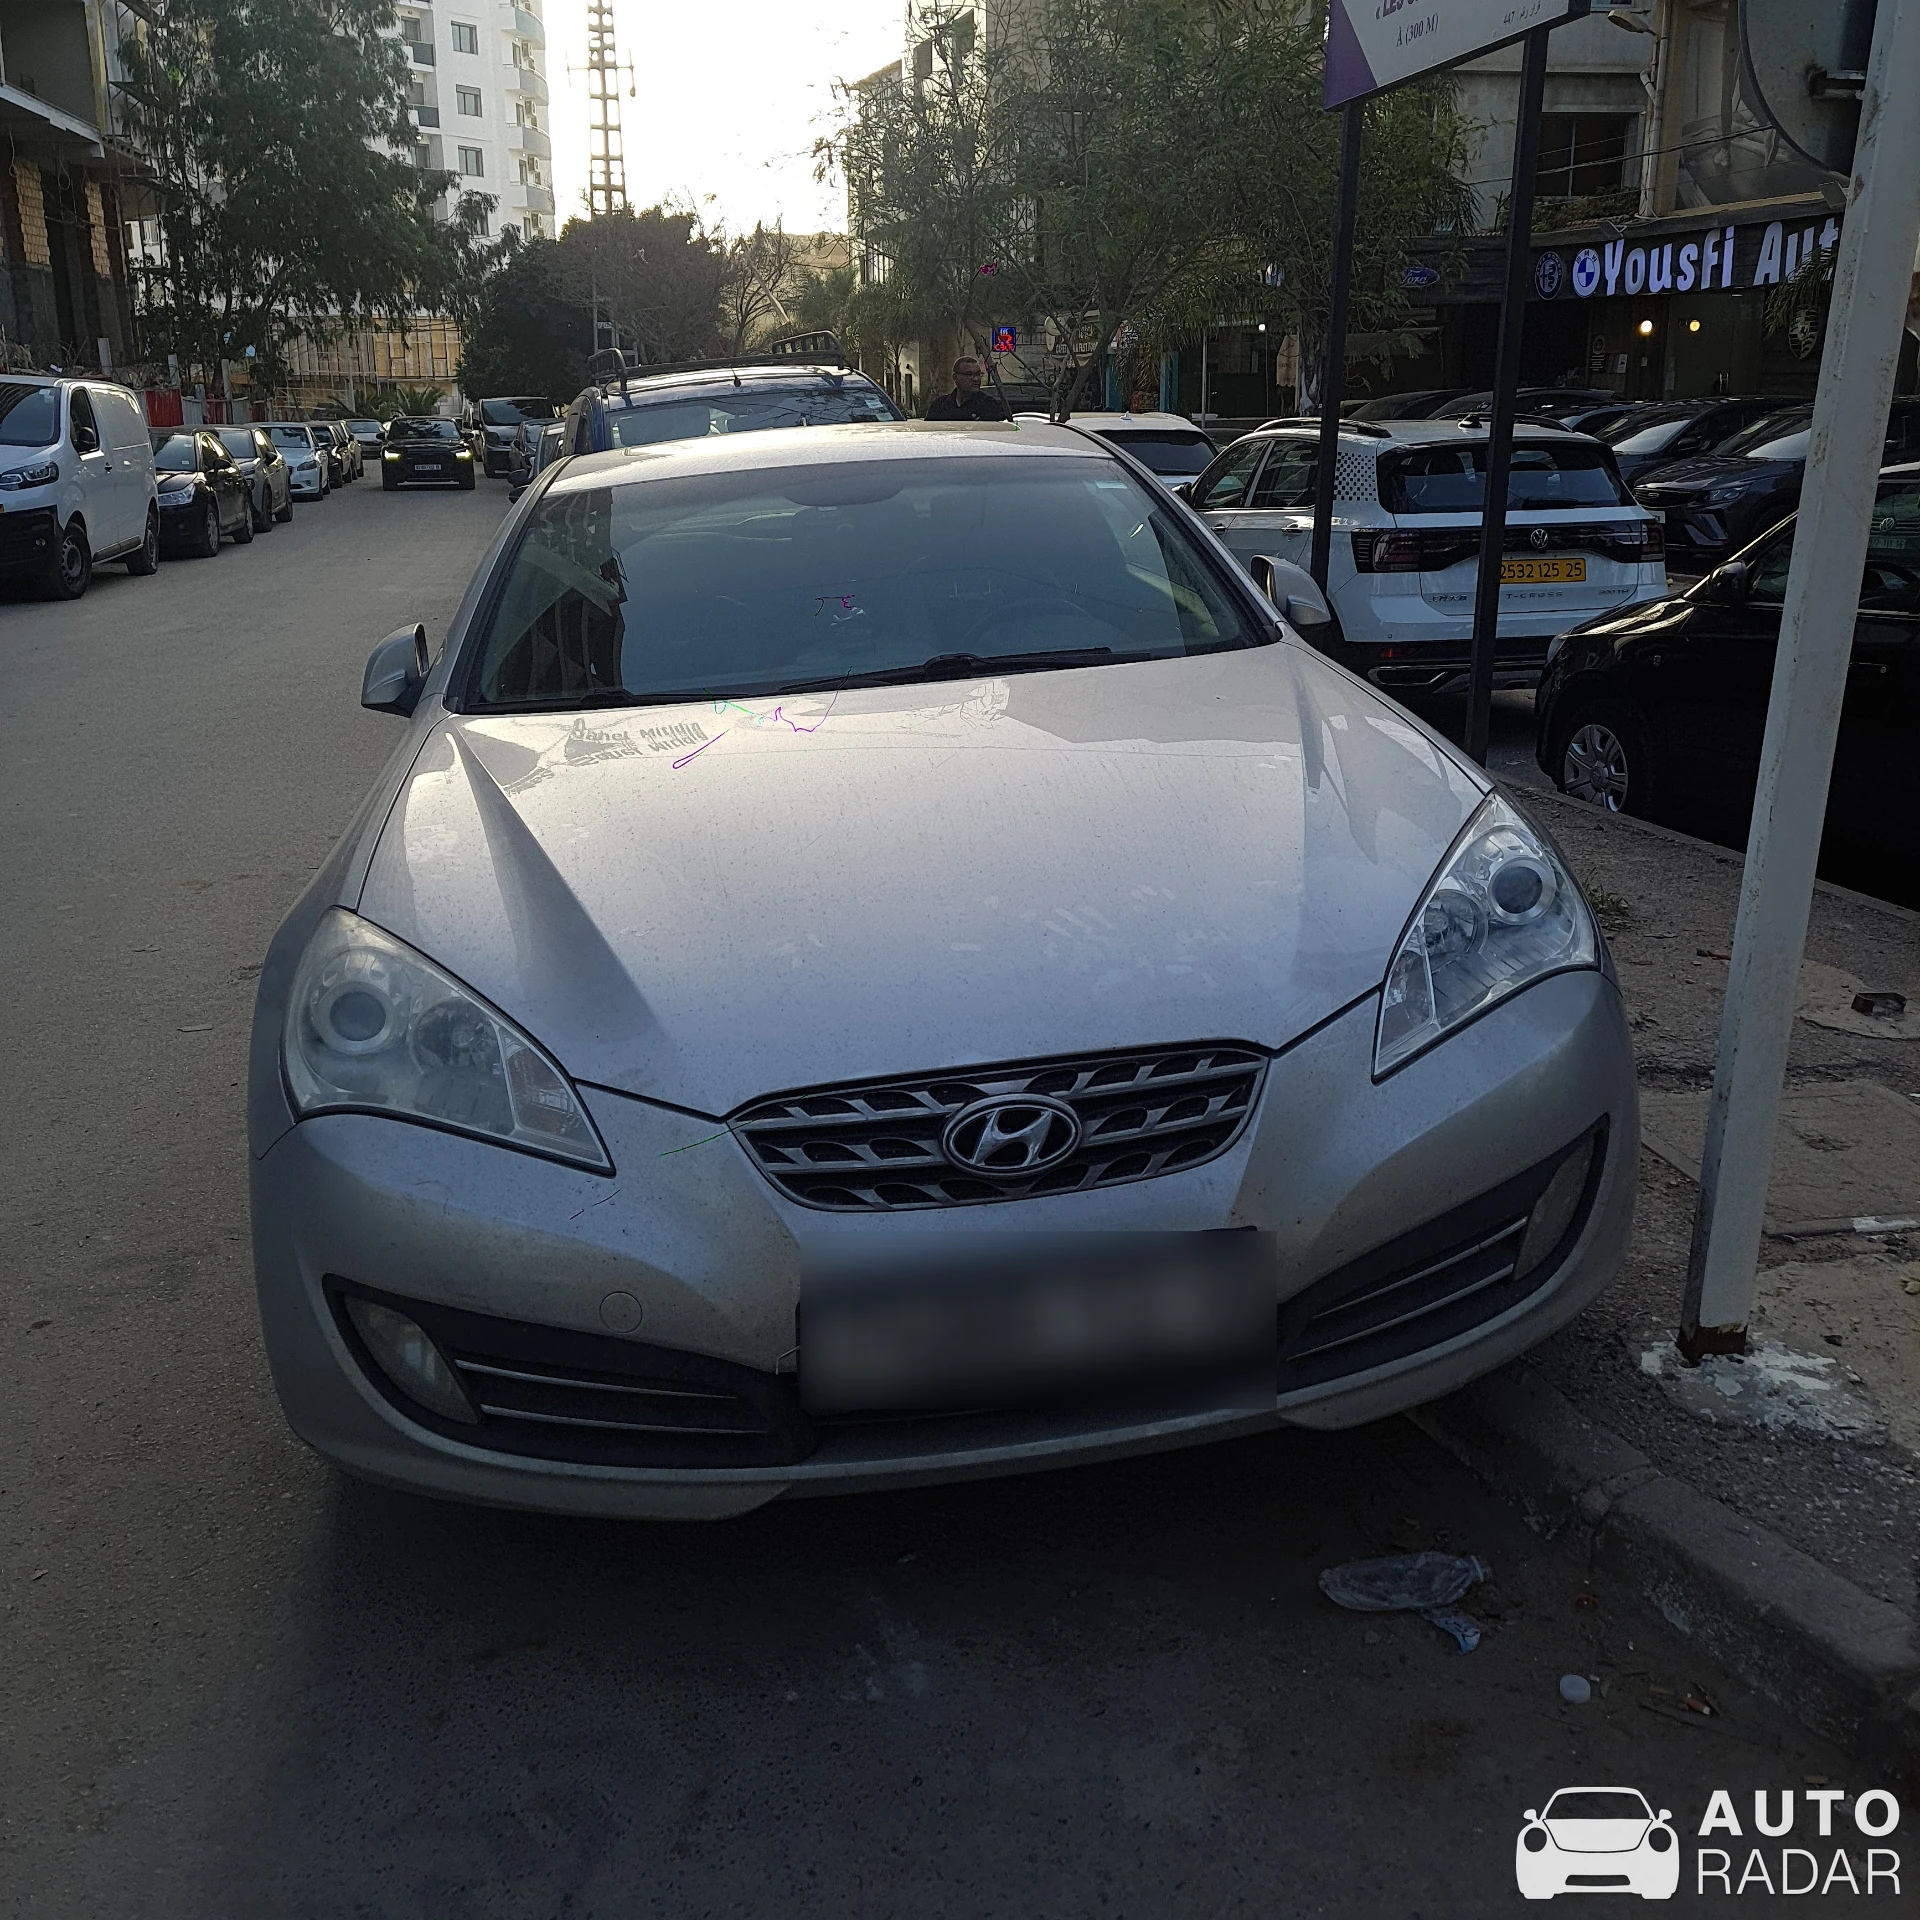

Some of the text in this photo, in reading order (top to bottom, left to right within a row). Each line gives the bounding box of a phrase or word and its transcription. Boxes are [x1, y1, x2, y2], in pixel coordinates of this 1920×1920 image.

[1405, 23, 1424, 46] (300
[1500, 562, 1583, 579] 2532 125 25
[1505, 591, 1564, 599] T-CROSS
